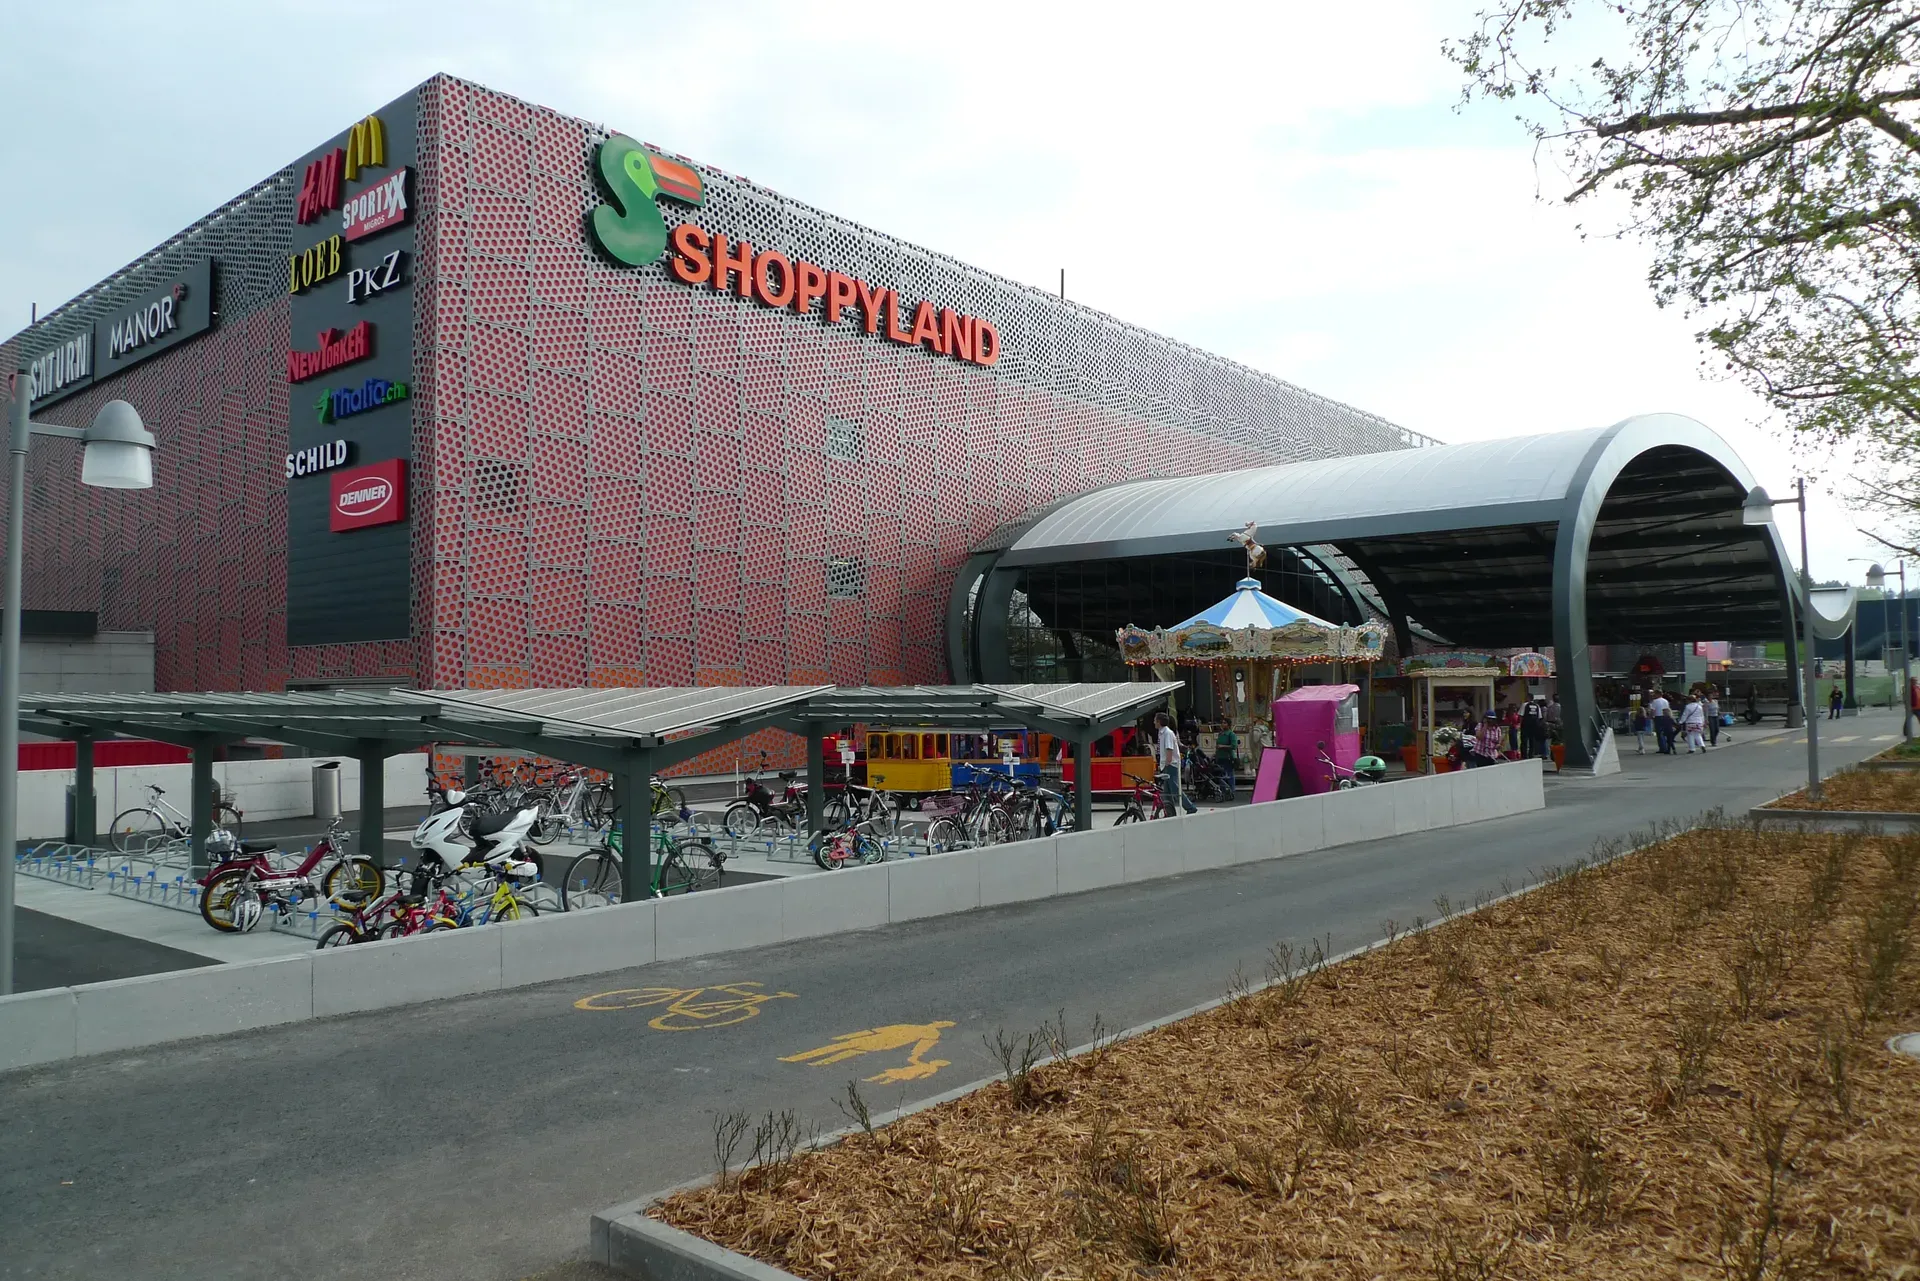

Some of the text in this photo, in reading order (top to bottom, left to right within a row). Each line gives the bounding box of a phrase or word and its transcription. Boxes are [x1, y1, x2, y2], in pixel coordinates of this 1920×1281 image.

[297, 148, 342, 224] H&M
[343, 171, 407, 229] SPORTXX
[363, 215, 385, 231] MIGROS
[289, 234, 341, 294] LOEB
[347, 250, 400, 303] PKZ
[672, 223, 999, 366] SHOPPYLAND
[110, 296, 173, 359] MANOR
[30, 333, 92, 401] SATURN
[329, 378, 407, 419] Thalia.ch
[285, 440, 347, 479] SCHILD
[339, 485, 386, 507] DENNER
